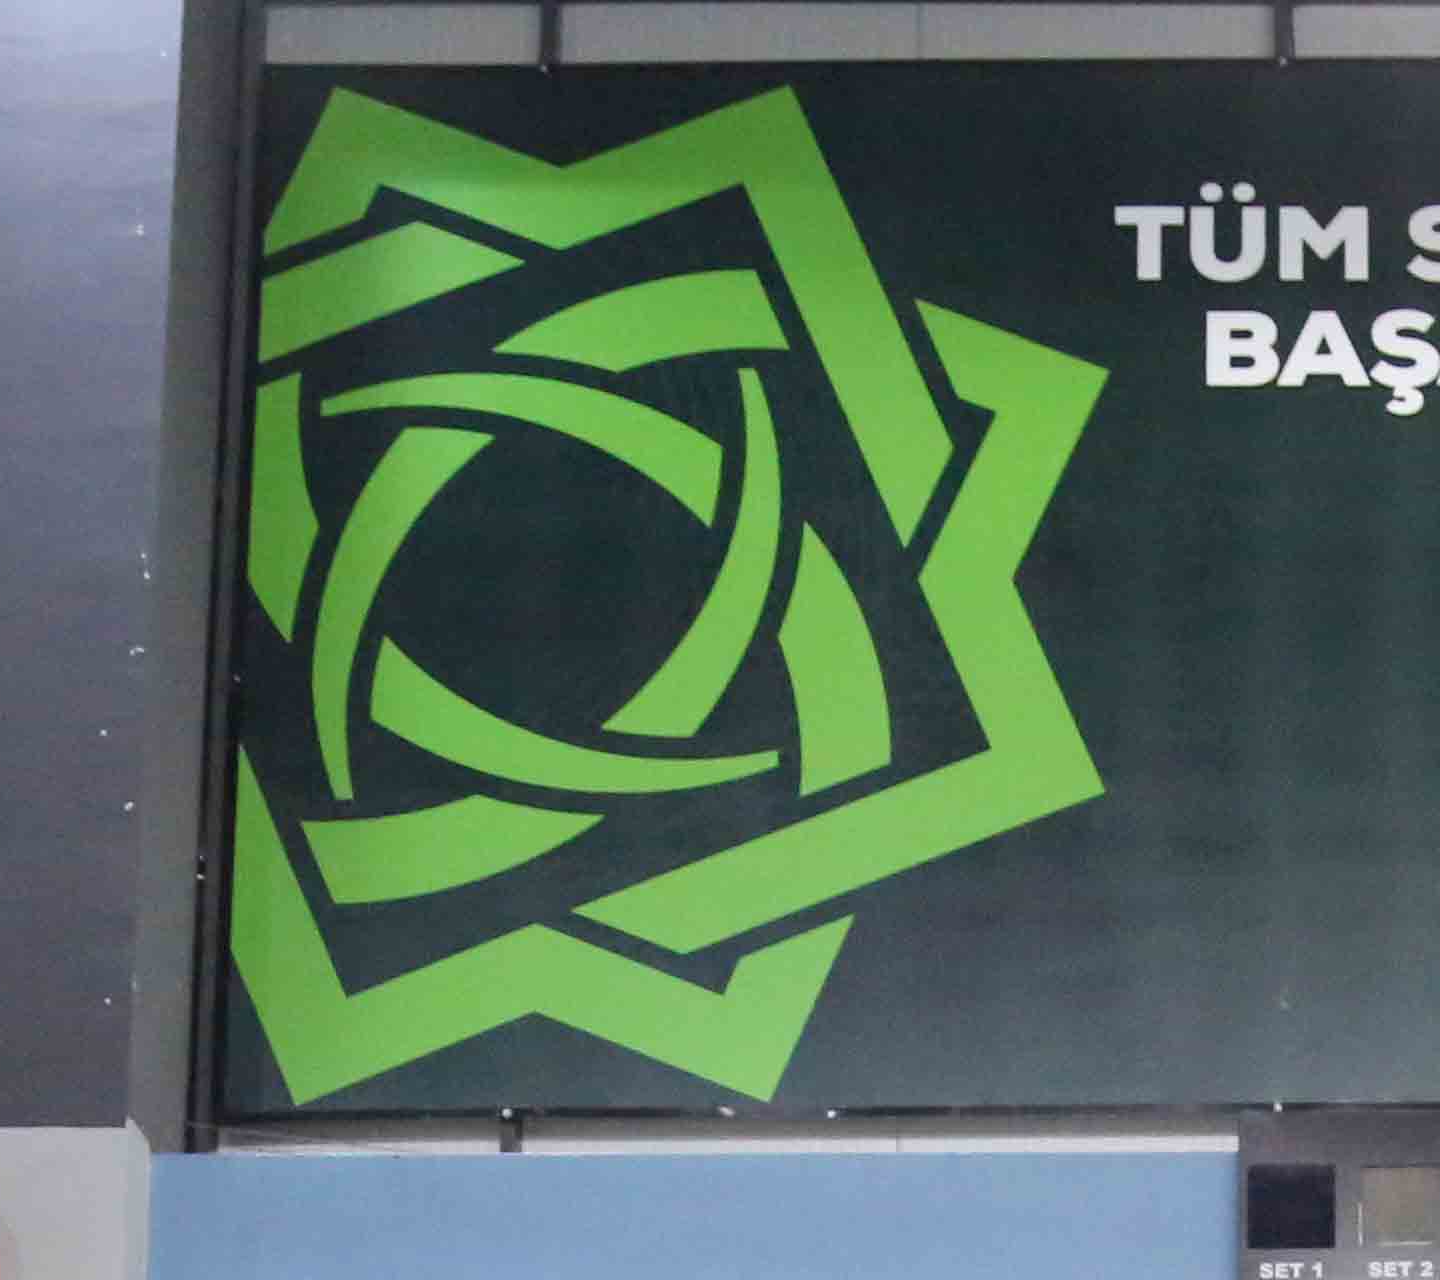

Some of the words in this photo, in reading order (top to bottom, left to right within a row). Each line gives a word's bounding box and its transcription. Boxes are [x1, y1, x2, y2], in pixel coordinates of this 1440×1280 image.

[1115, 183, 1369, 282] TÜM
[1259, 1261, 1304, 1280] SET
[1309, 1261, 1325, 1280] 1
[1368, 1260, 1413, 1279] SET
[1417, 1260, 1435, 1279] 2
